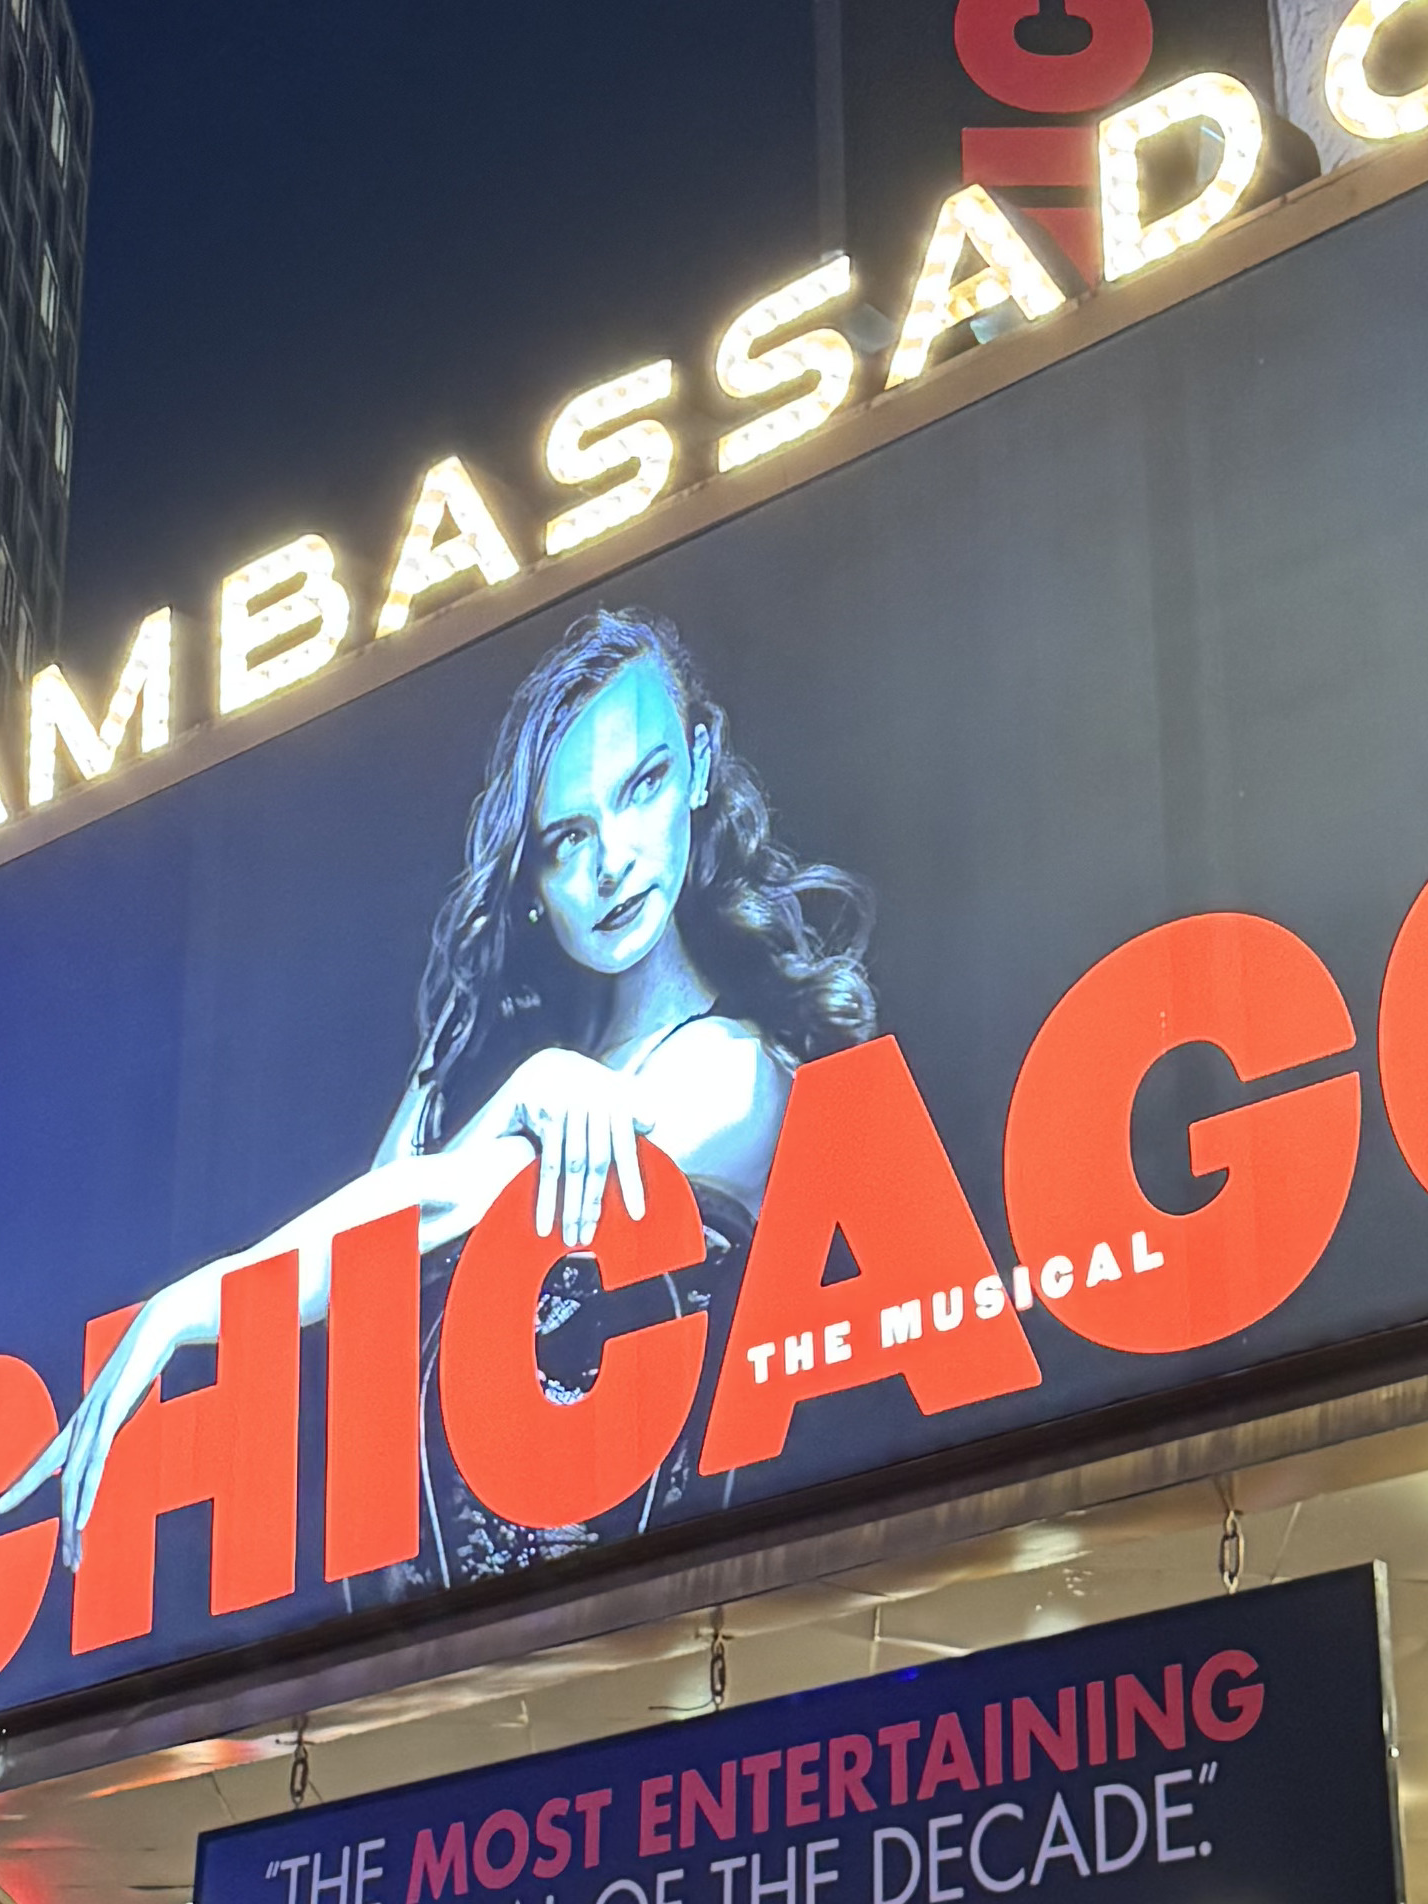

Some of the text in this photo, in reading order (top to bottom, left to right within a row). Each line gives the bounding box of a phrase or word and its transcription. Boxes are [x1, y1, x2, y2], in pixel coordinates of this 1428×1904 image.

[747, 1230, 1165, 1385] THE MUSICAL
[638, 1647, 1266, 1858] ENTERTAINING
